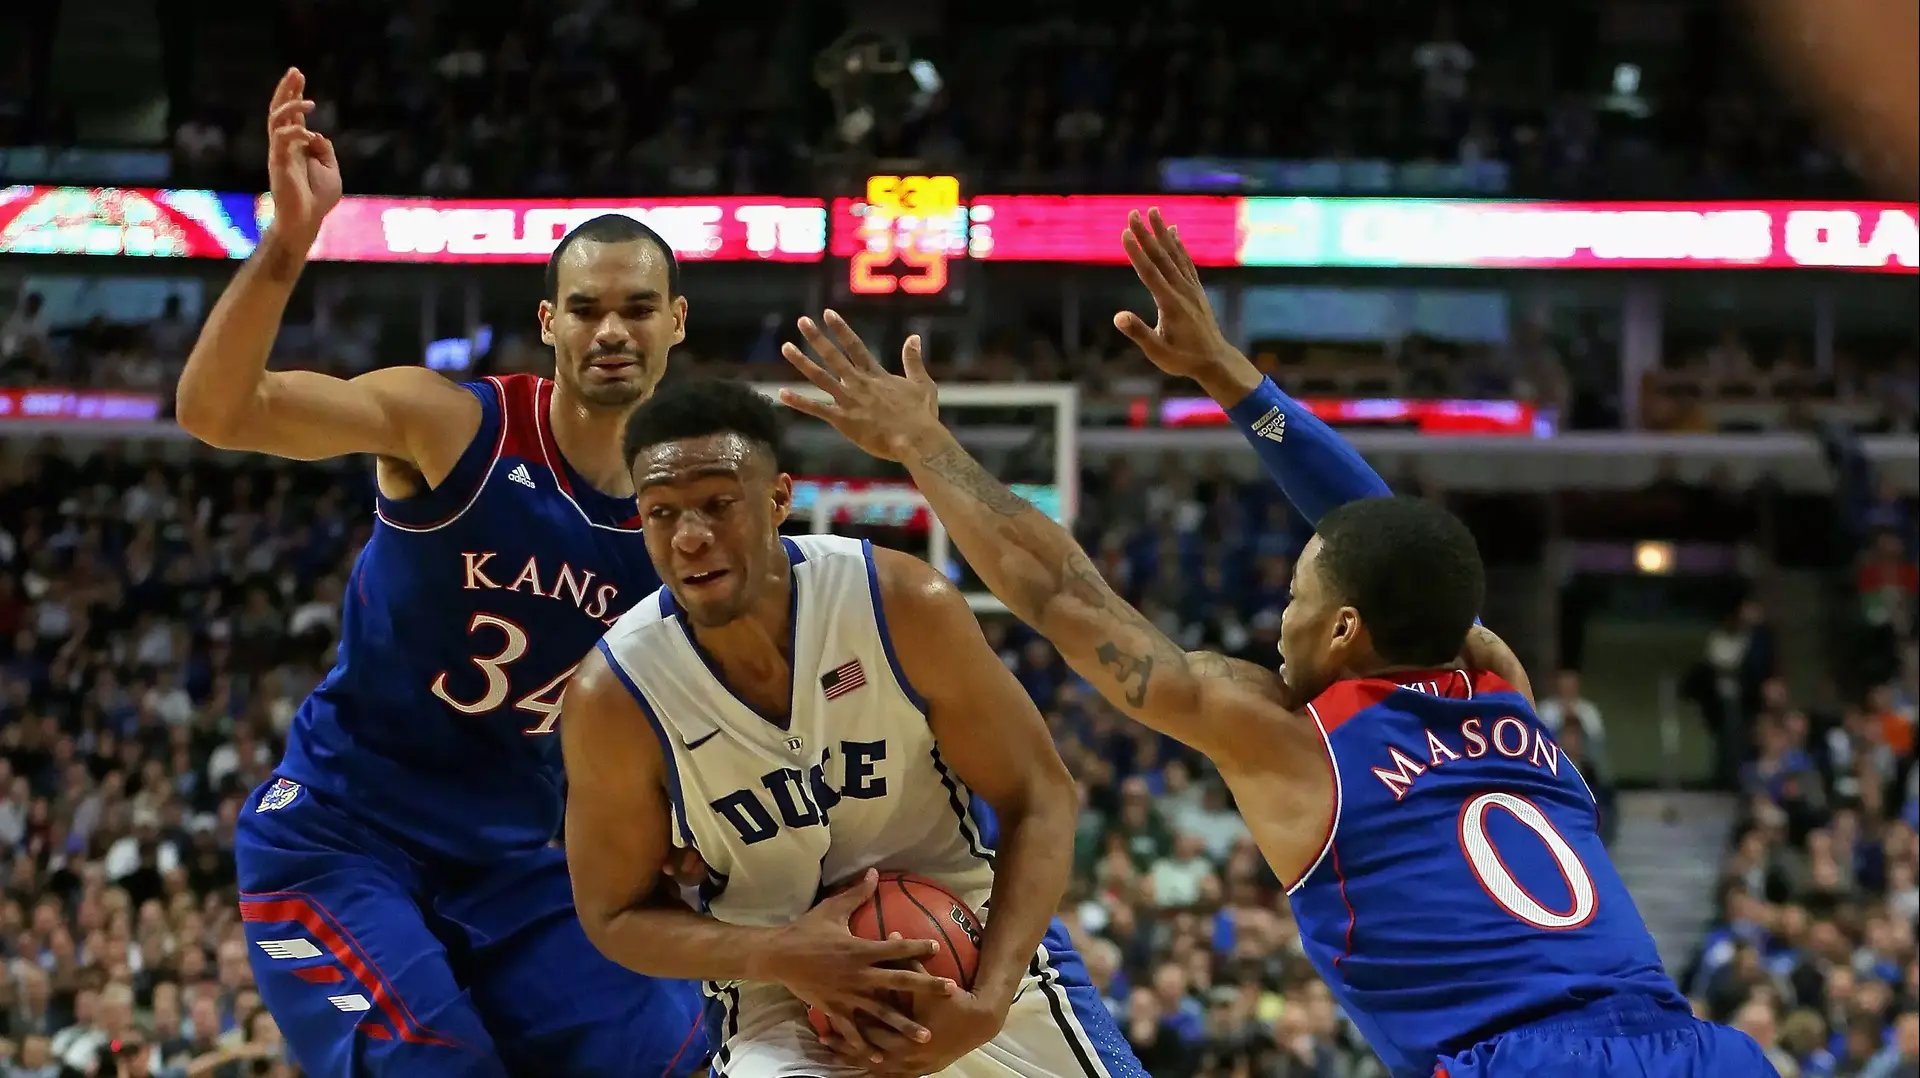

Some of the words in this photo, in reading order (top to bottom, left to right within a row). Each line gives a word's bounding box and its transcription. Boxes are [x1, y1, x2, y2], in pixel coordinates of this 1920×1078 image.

[1257, 413, 1286, 438] adidas
[507, 473, 536, 489] adidas
[460, 551, 622, 627] KANS
[430, 611, 580, 735] 34
[1371, 716, 1562, 801] MASON
[1457, 791, 1599, 930] 0
